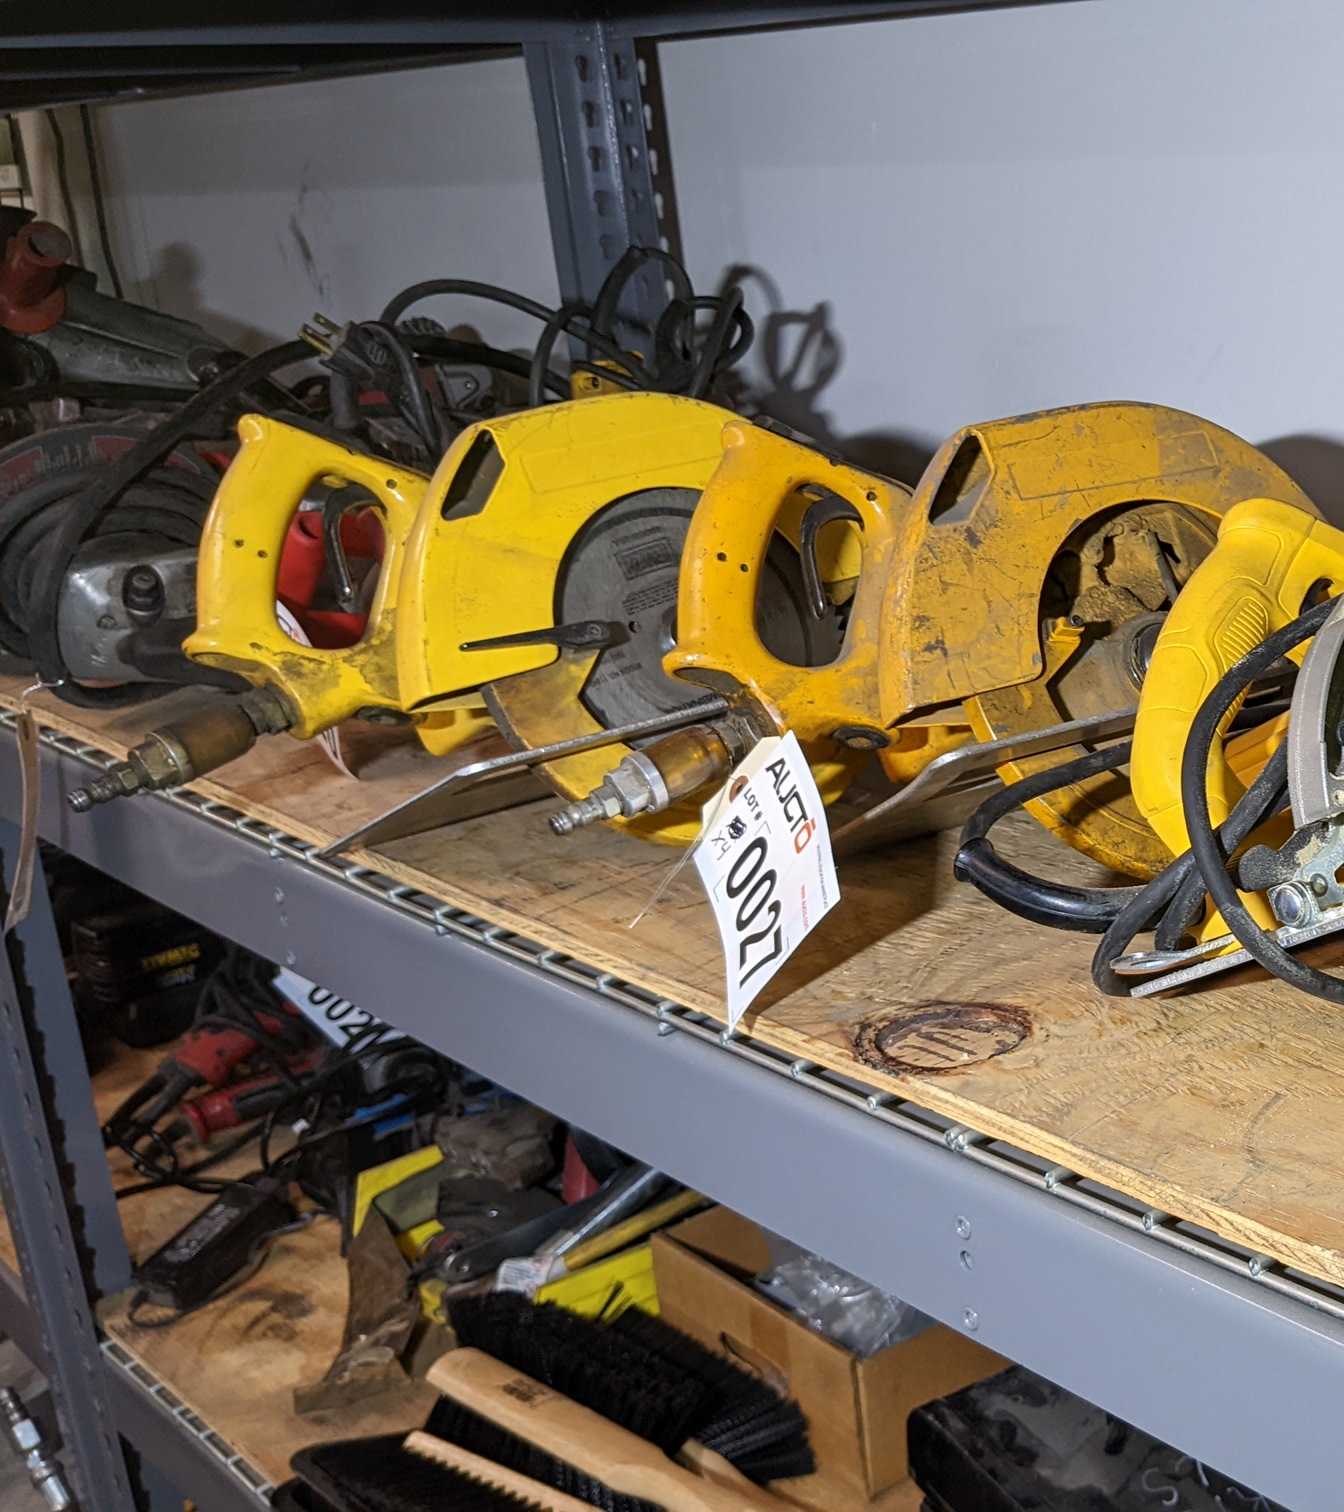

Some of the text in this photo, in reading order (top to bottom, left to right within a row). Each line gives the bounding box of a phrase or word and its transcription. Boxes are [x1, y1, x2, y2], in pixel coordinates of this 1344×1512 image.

[743, 788, 759, 813] LOT
[726, 836, 782, 989] 0027
[308, 985, 388, 1044] 002
